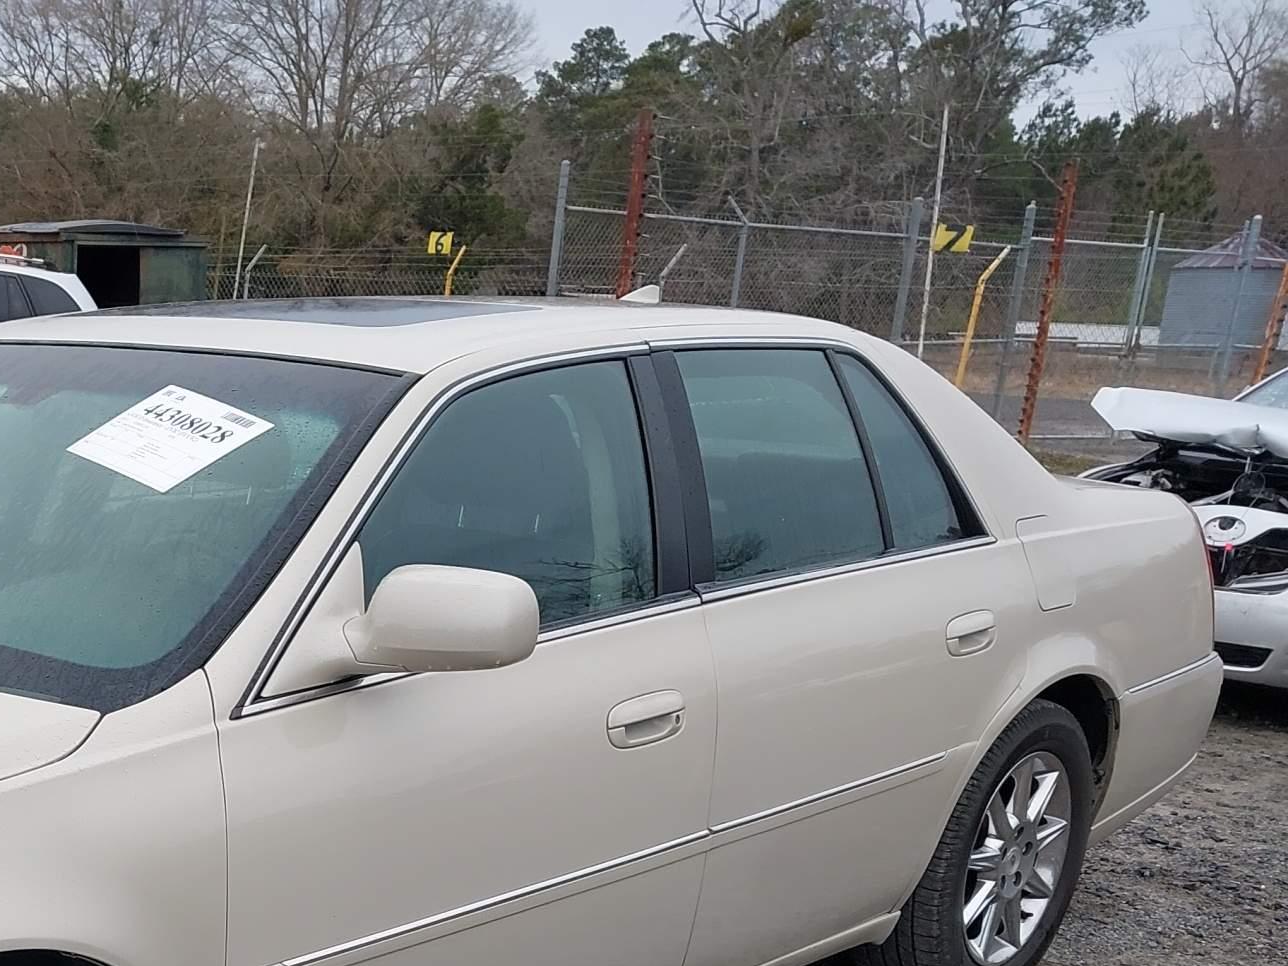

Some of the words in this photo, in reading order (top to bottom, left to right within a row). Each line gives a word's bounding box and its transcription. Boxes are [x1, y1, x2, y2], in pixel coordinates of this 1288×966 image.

[435, 231, 447, 254] 6
[940, 223, 968, 253] 7
[143, 403, 234, 444] 44308028
